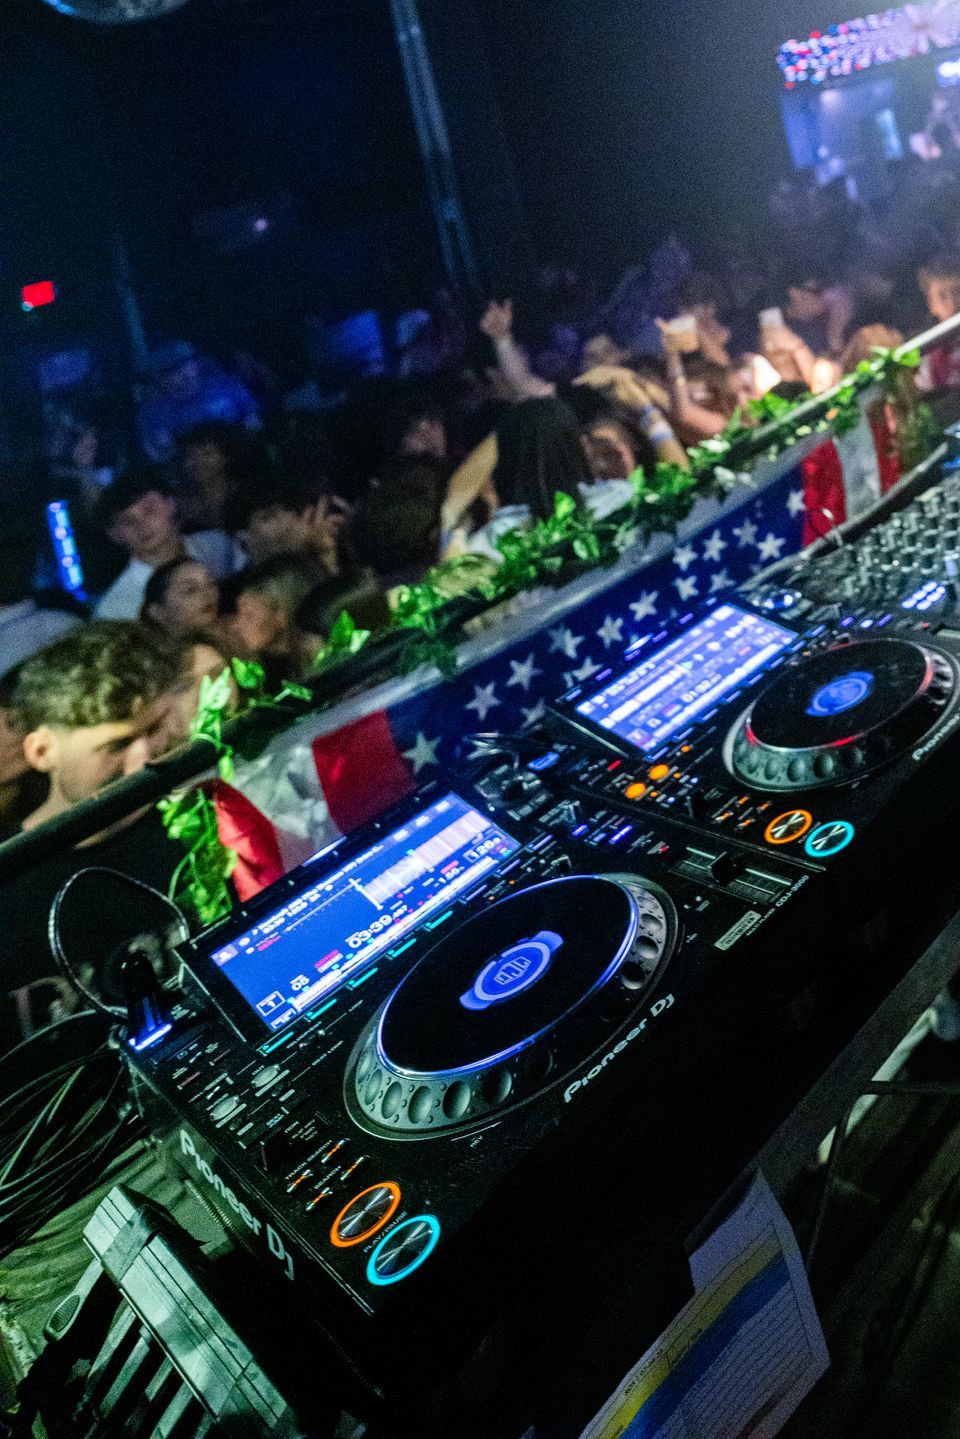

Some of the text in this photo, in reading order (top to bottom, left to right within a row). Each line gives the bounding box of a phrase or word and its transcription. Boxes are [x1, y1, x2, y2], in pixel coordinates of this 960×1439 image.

[775, 875, 809, 907] CDJ-3000
[563, 1018, 648, 1103] Pioneer
[180, 1128, 262, 1235] Pioneer
